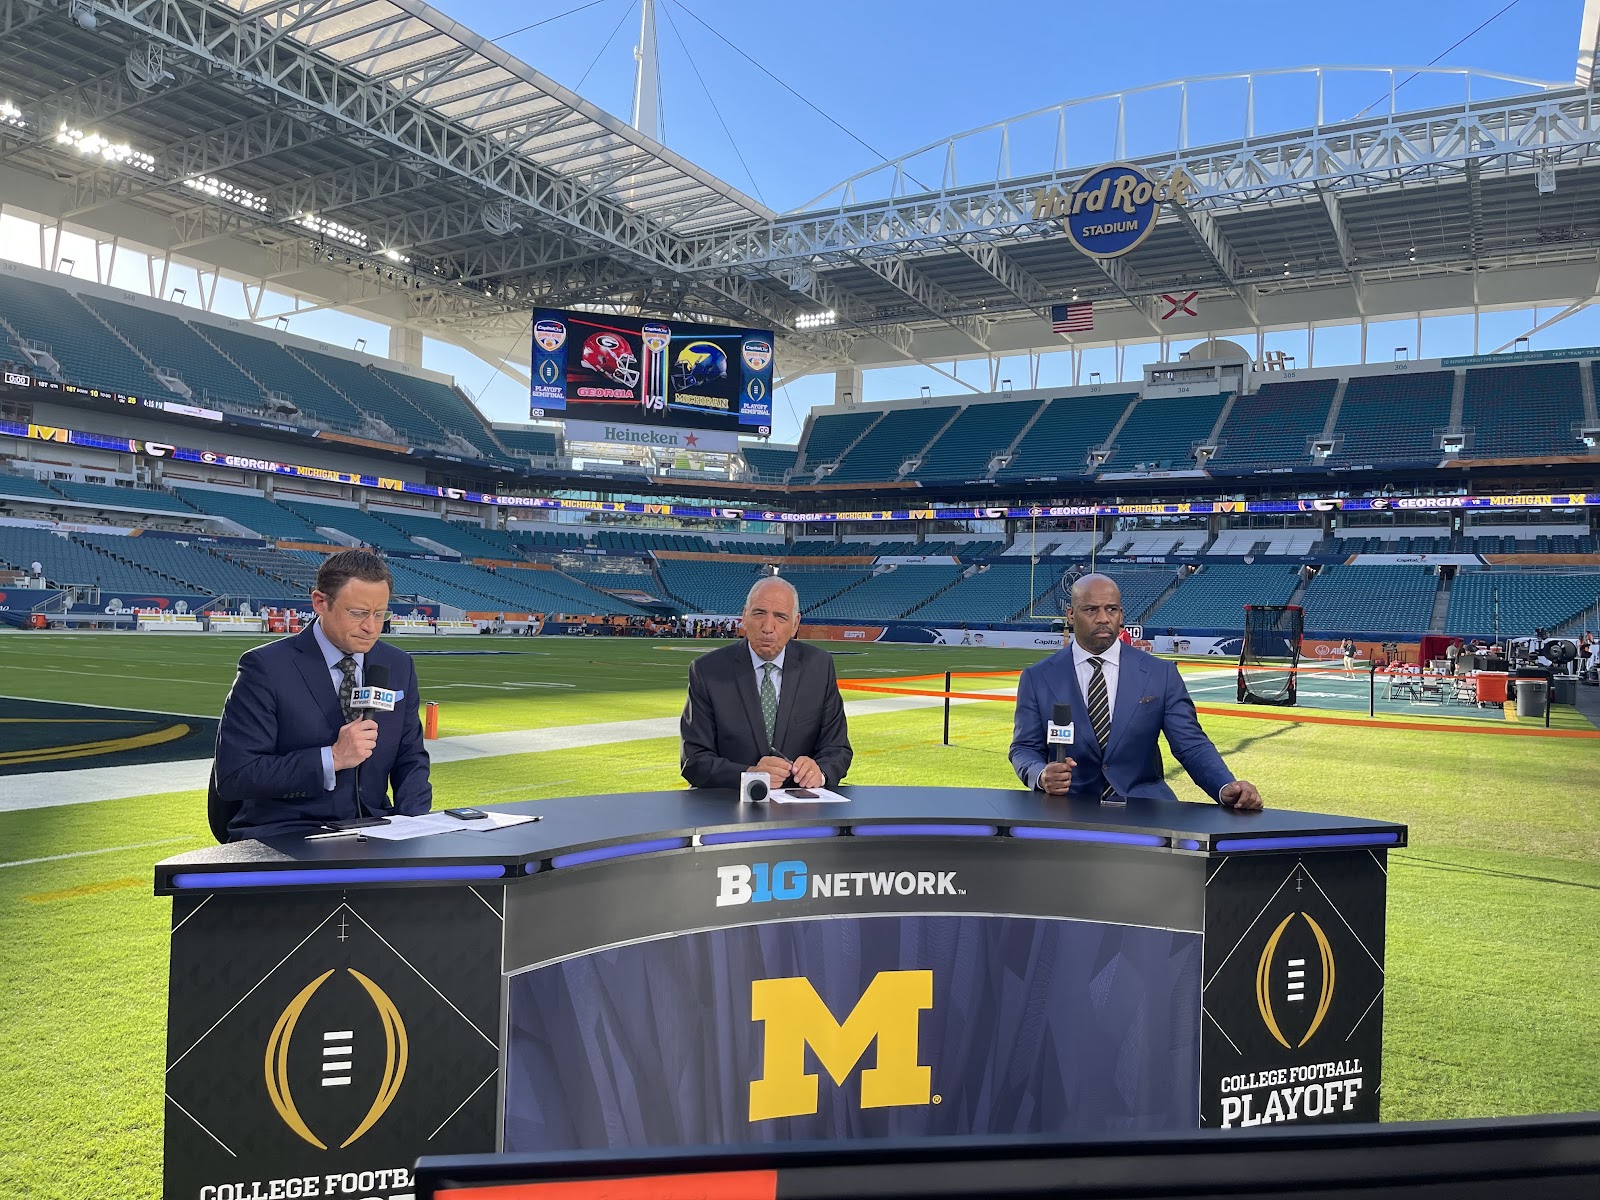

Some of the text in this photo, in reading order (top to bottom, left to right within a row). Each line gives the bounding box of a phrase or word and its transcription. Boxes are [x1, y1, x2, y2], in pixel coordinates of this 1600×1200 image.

[1032, 167, 1191, 220] Hard Rock
[1082, 220, 1139, 237] STADIUM
[9, 375, 26, 384] 0:00
[90, 390, 99, 398] 10
[532, 391, 565, 399] SEMIFINAL
[535, 385, 562, 393] PLAYOFF
[577, 387, 634, 399] GEORGIA
[645, 395, 664, 409] VS
[674, 393, 729, 409] MICHIGAN
[740, 408, 770, 416] SEMIFINAL
[604, 427, 679, 445] Heineken
[225, 455, 277, 471] GEORGIA
[296, 466, 340, 481] MICHIGAN
[350, 473, 361, 484] M
[560, 500, 603, 509] MICHIGAN
[613, 502, 625, 511] M
[1398, 497, 1462, 507] GEORGIA
[1490, 495, 1551, 505] MICHIGAN
[1569, 494, 1586, 504] M
[781, 513, 821, 521] GEORGIA
[836, 512, 873, 520] MICHIGAN
[881, 511, 892, 519] M
[1050, 507, 1097, 515] GEORGIA
[1118, 505, 1165, 513] MICHIGAN
[1178, 503, 1191, 512] M
[812, 871, 957, 898] NETWORK
[749, 969, 933, 1122] M
[1221, 1059, 1362, 1093] COLLEGE FOOTBALL
[1220, 1078, 1362, 1129] PLAYOFF
[200, 1176, 320, 1200] COLLEGE
